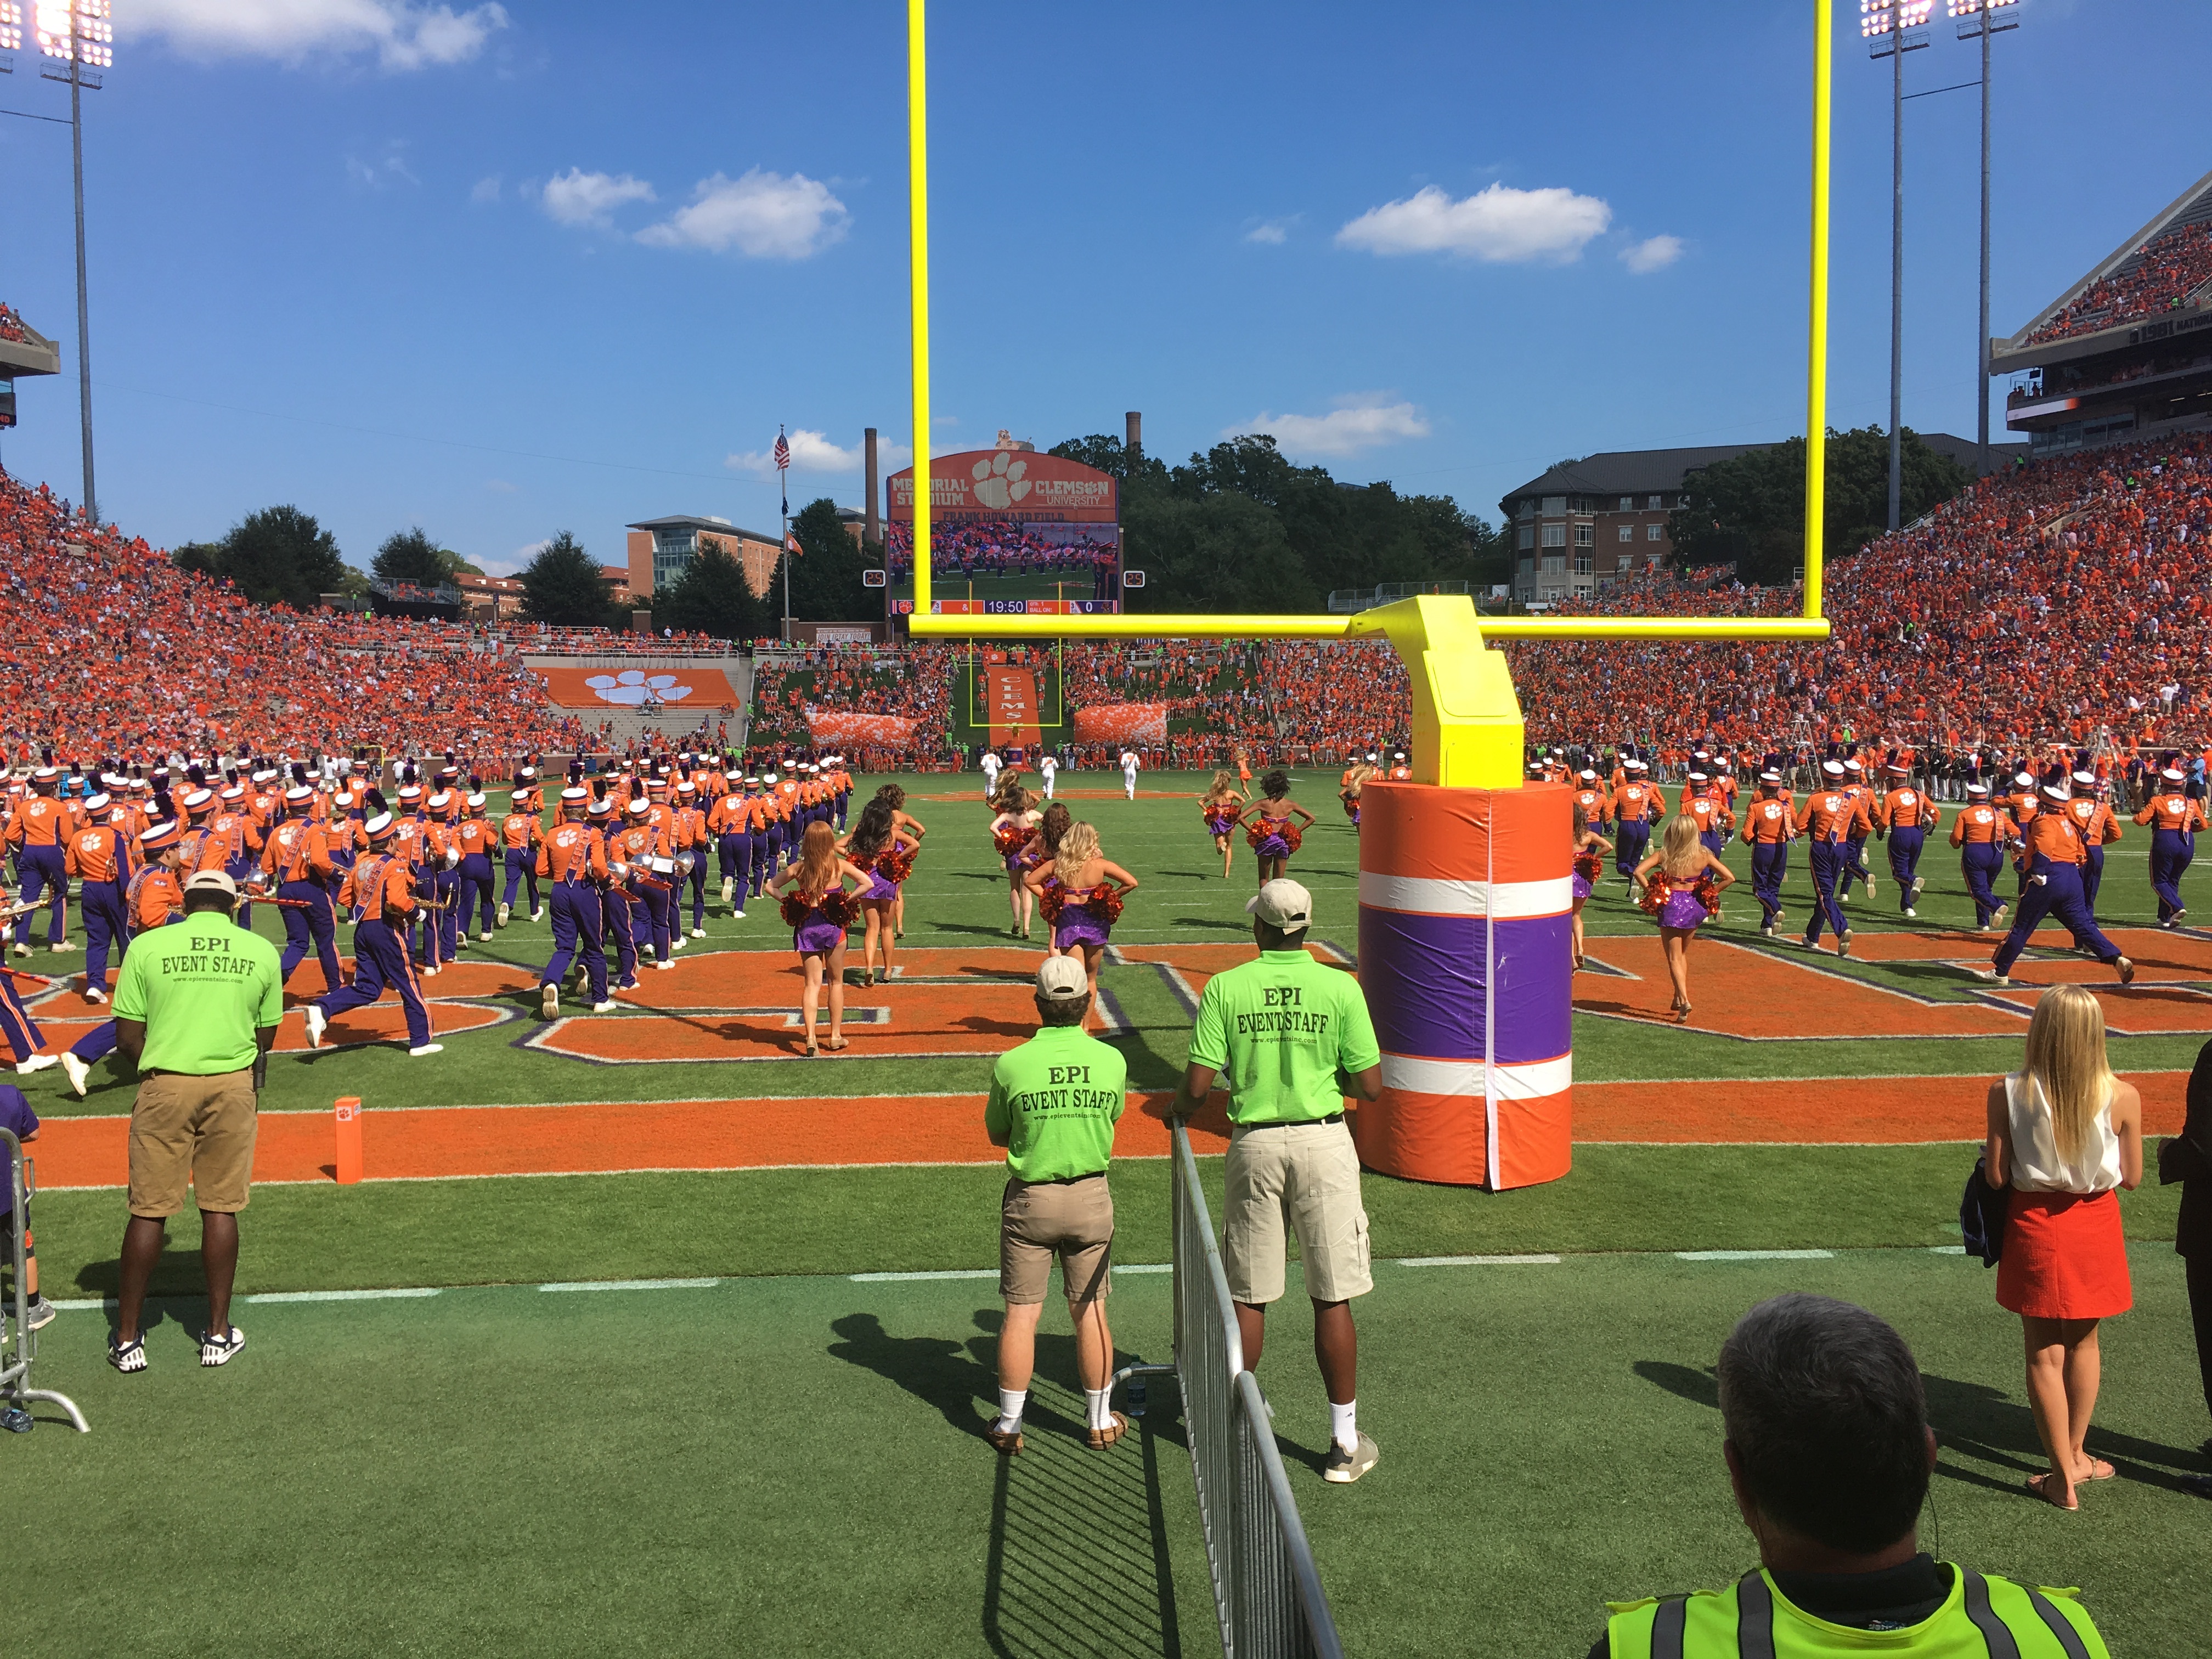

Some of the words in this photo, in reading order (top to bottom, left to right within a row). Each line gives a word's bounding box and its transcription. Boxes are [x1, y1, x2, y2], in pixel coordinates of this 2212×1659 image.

[1047, 496, 1101, 505] UNIVERSITY
[943, 511, 980, 522] FRANK
[983, 511, 1032, 522] HOWARD
[1034, 512, 1064, 522] FIELD
[867, 573, 882, 584] 25
[1127, 574, 1142, 585] 25
[989, 601, 1023, 613] 19:50
[1086, 602, 1093, 612] 0
[190, 936, 230, 952] EPI
[162, 955, 208, 974] EVENT
[212, 956, 256, 977] STAFF
[172, 976, 244, 985] www.epieventsinc.com
[1263, 987, 1302, 1007] EPI
[1237, 1012, 1283, 1034] EVENT
[1284, 1011, 1329, 1034] STAFF
[1048, 1065, 1091, 1085] EPI
[1021, 1089, 1068, 1112] EVENT
[1073, 1088, 1113, 1110] STAFF
